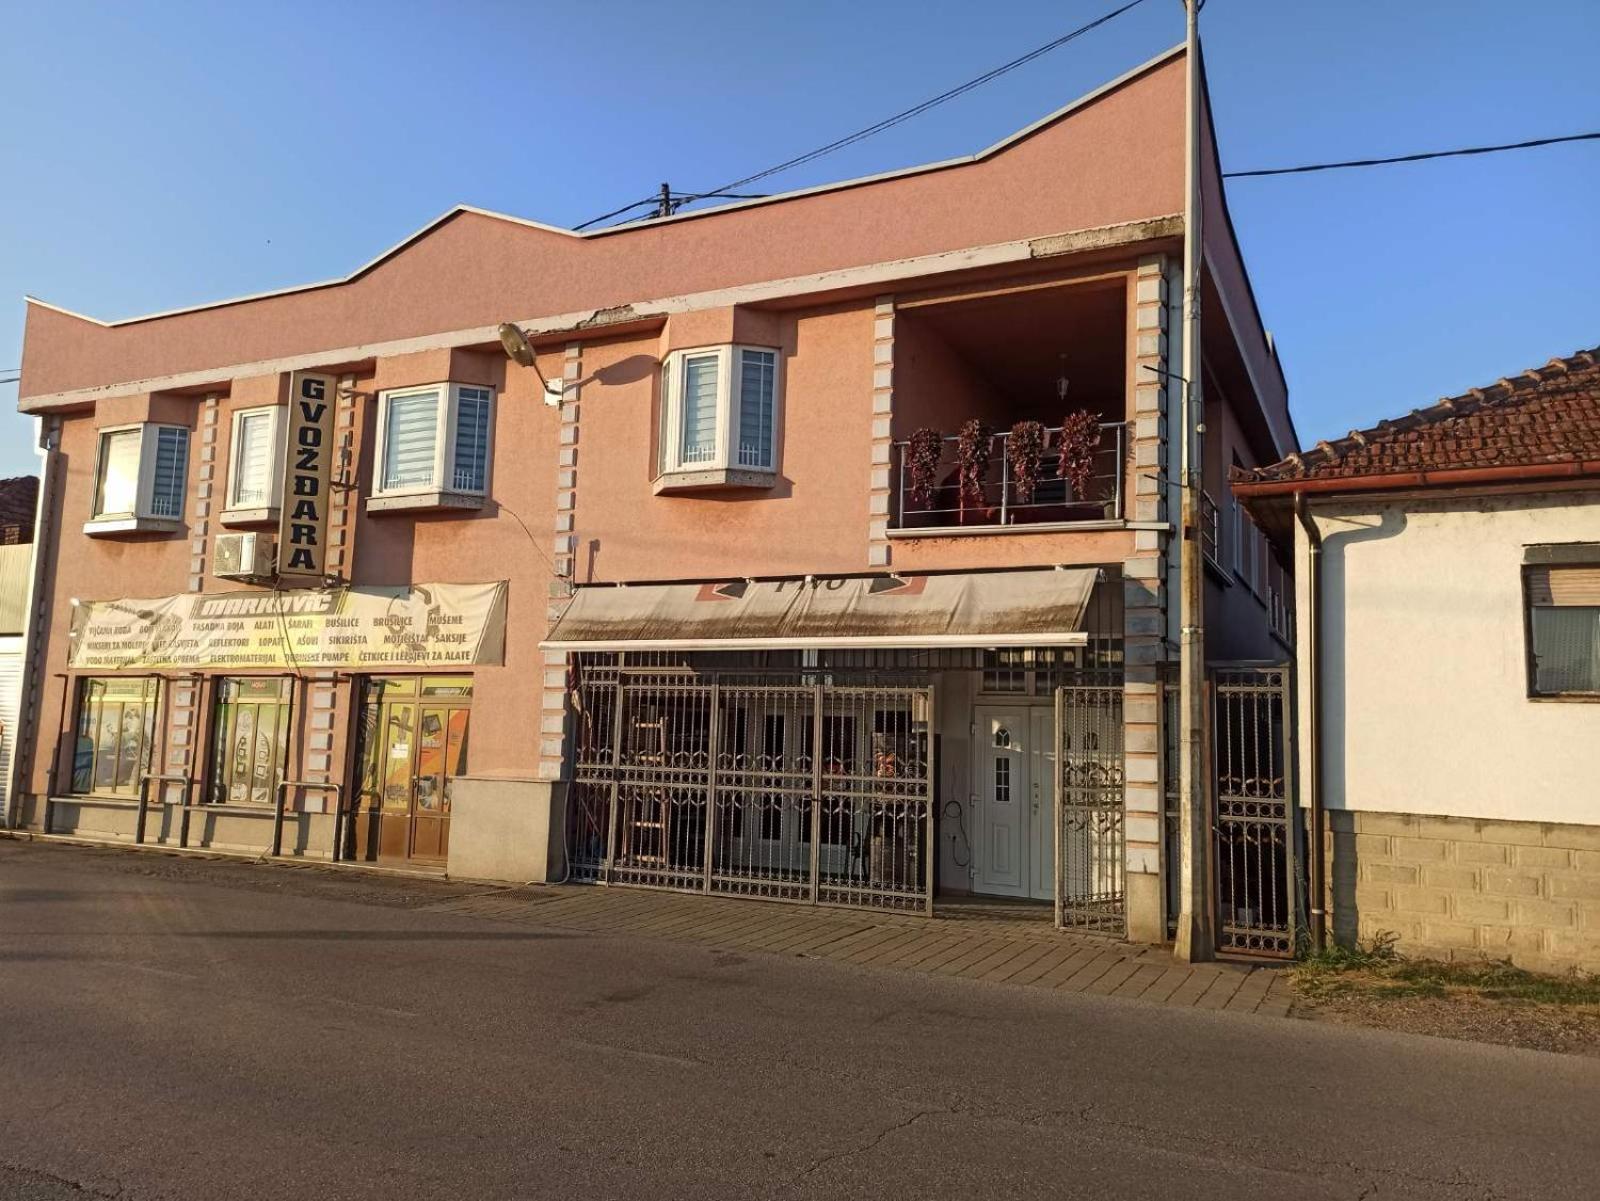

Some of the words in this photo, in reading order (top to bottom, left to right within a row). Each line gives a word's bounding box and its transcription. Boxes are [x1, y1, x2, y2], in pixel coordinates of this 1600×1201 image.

[254, 620, 275, 630] ALATI
[325, 617, 360, 628] BUŠILICE
[373, 616, 413, 627] BRUSILICE
[435, 632, 467, 645] SAKSIJE
[321, 651, 350, 662] PUMPE
[359, 650, 390, 662] ČETKICE
[431, 650, 444, 661] ZA
[444, 650, 471, 661] ALATE
